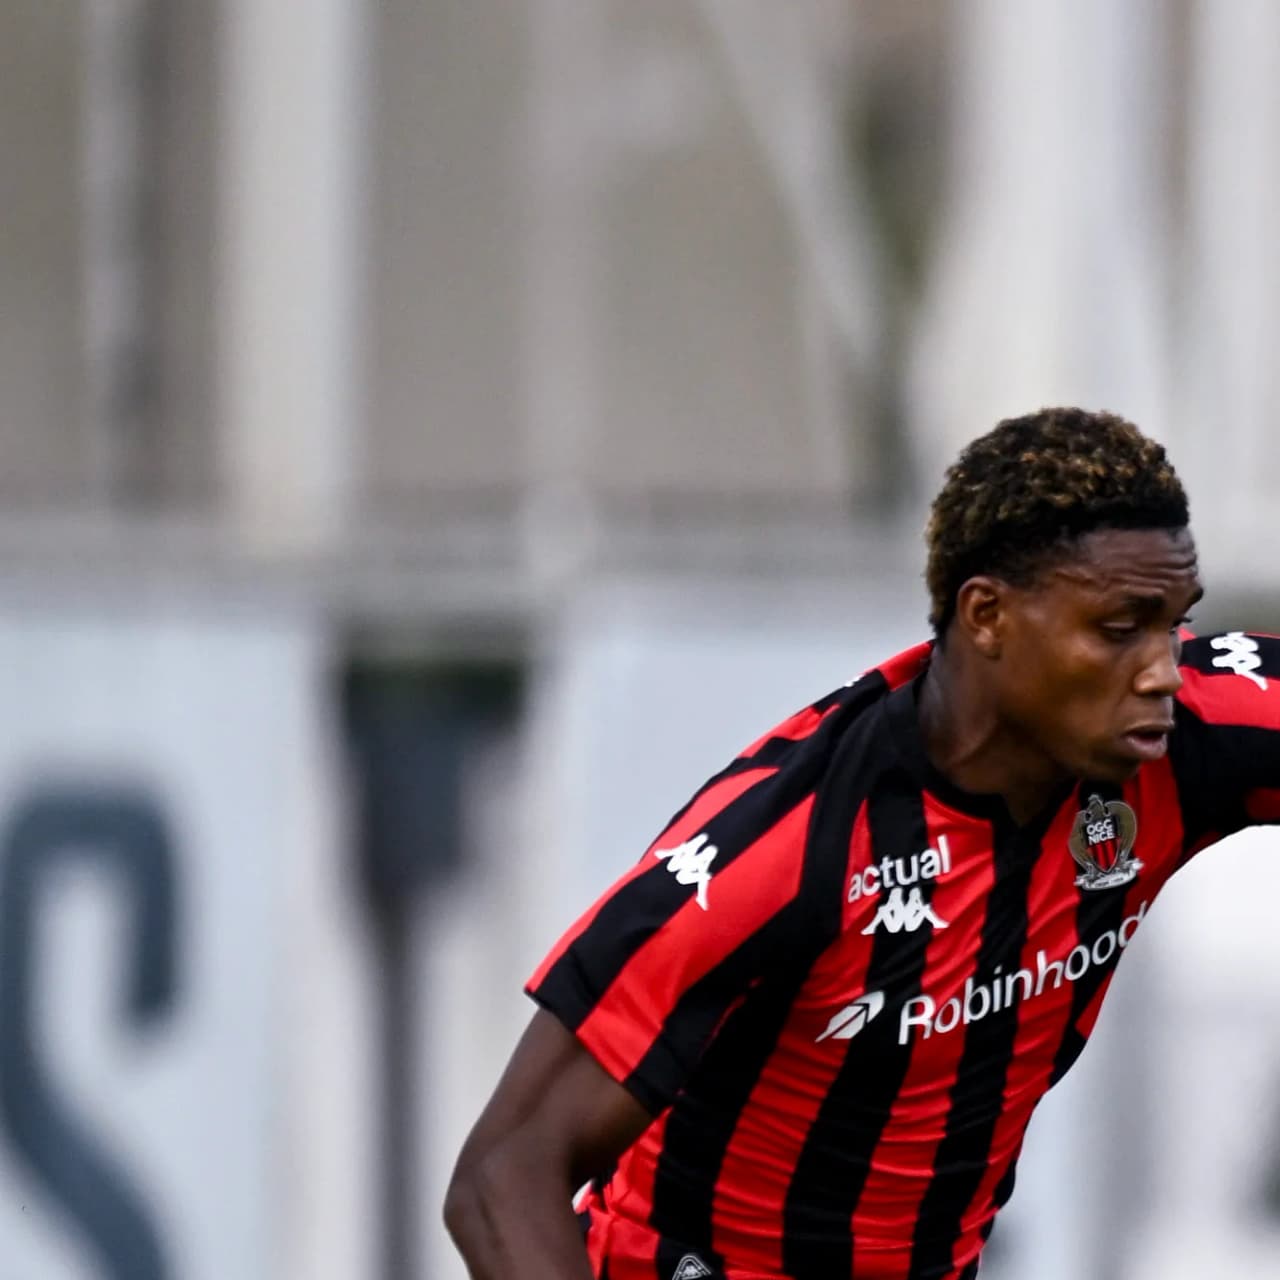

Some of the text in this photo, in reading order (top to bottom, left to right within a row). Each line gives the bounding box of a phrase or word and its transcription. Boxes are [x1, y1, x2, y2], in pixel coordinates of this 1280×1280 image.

[1086, 818, 1113, 836] OGC
[1087, 828, 1116, 846] NICE
[847, 834, 951, 904] actual
[897, 900, 1148, 1046] Robinhood
